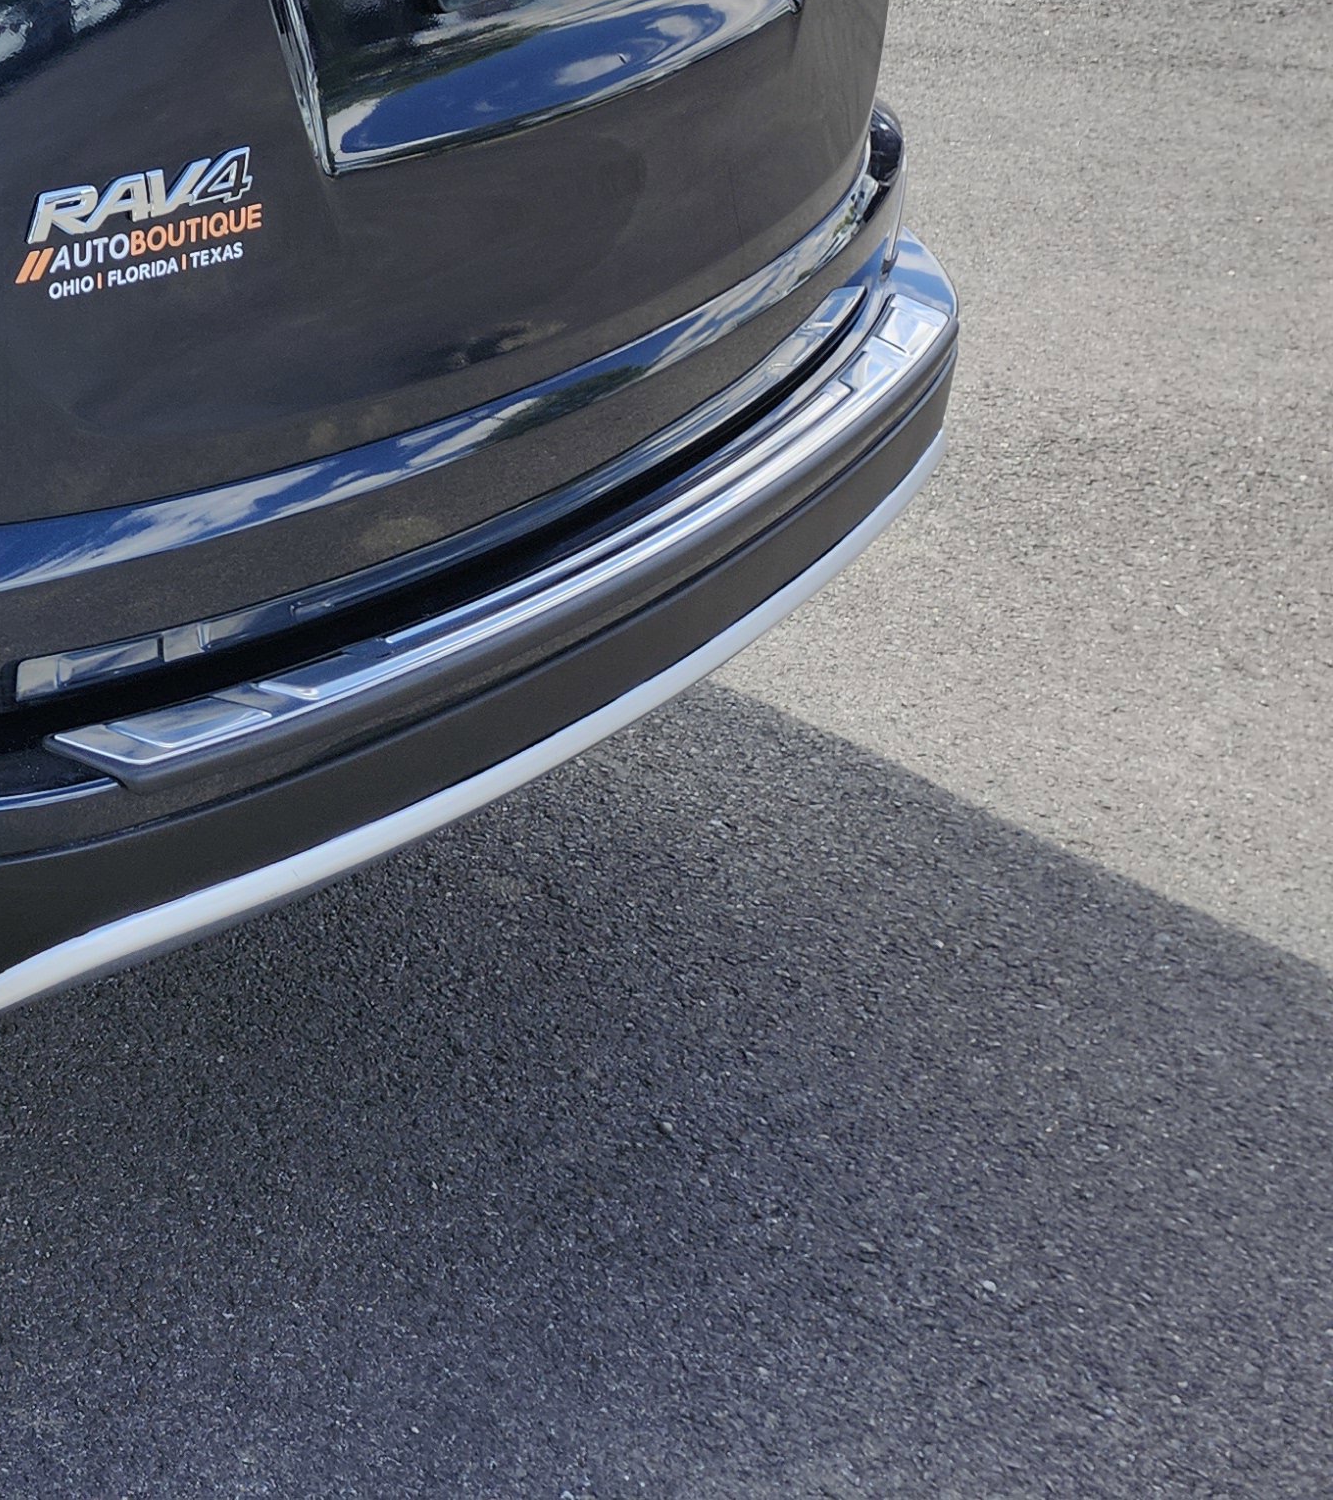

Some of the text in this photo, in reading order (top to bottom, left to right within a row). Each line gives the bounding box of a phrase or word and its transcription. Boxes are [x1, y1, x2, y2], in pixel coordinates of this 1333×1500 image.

[25, 145, 253, 245] RAV4
[48, 242, 244, 300] OHIO FLORIDA TEXAS
